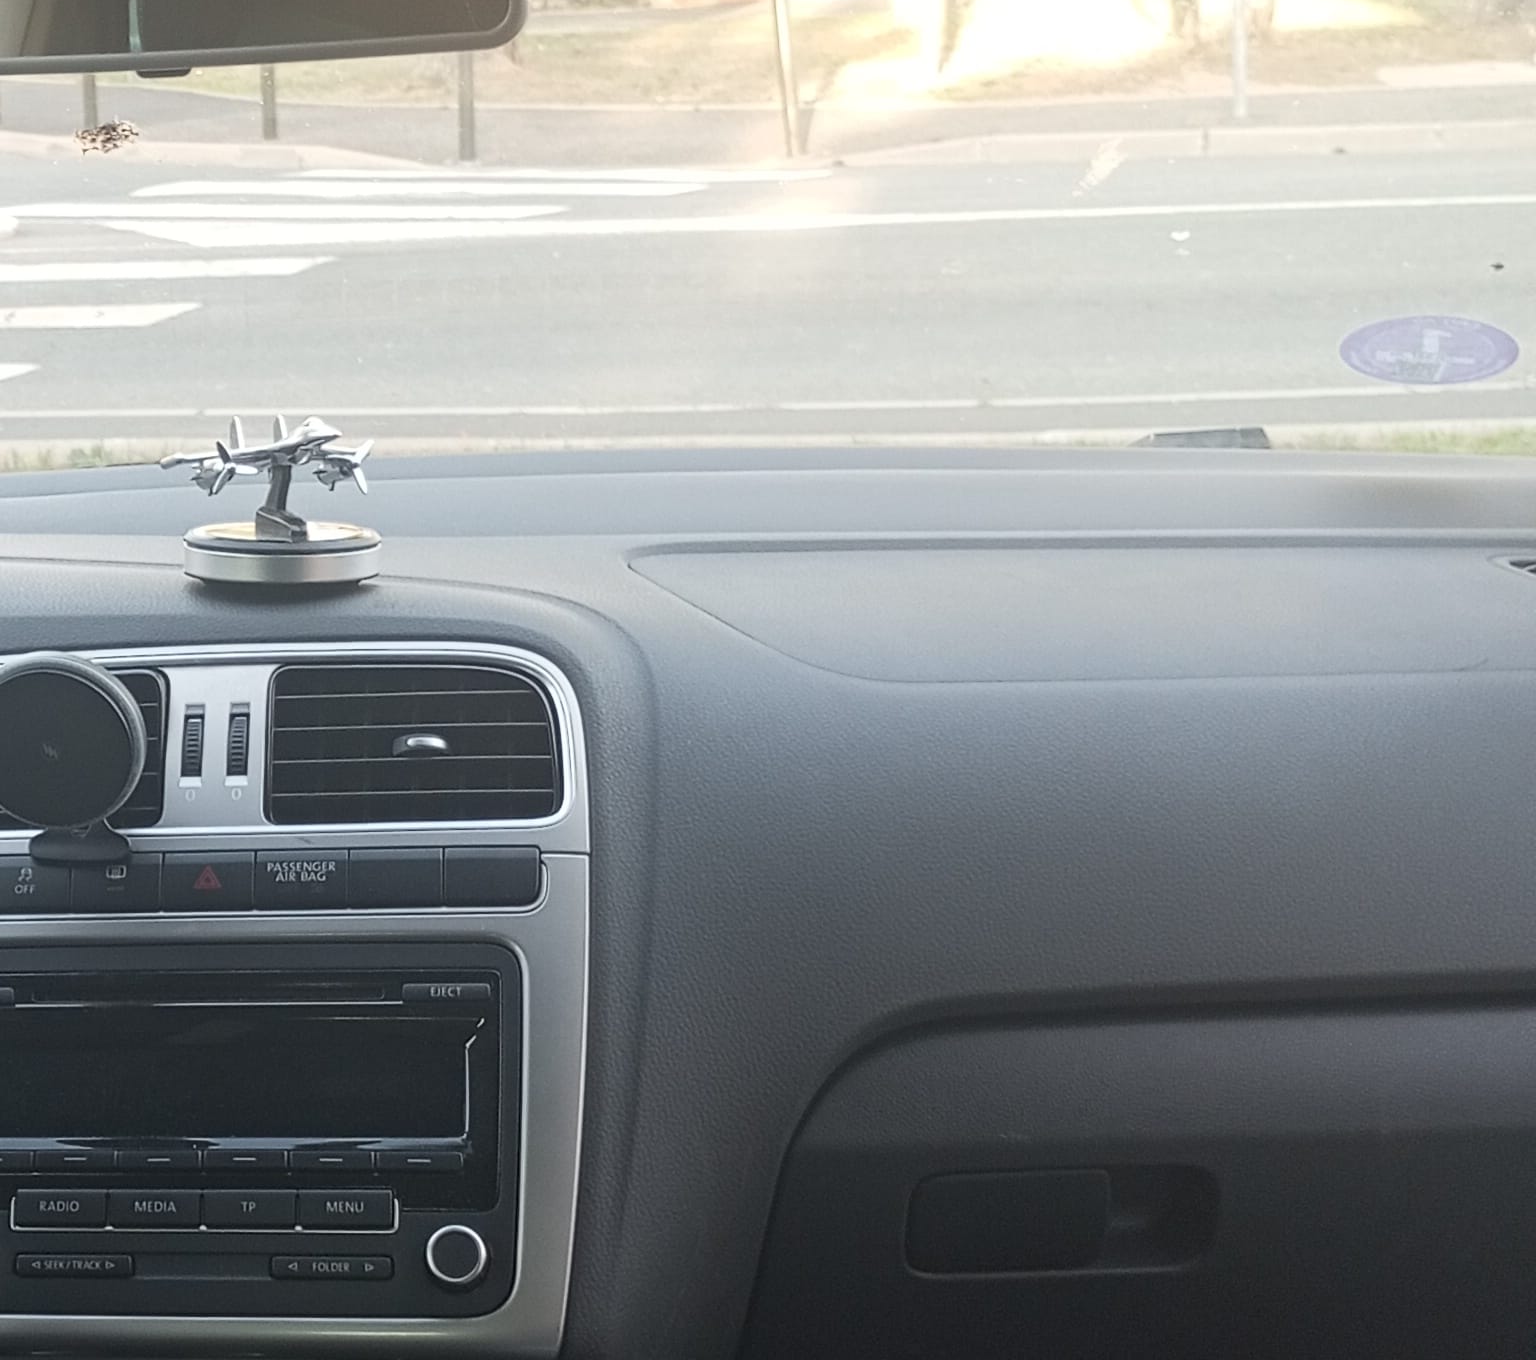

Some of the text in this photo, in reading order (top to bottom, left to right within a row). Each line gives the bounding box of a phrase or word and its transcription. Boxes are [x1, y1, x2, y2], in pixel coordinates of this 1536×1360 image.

[267, 861, 336, 872] PASSENGER
[275, 871, 326, 882] AIR BAG
[15, 884, 36, 894] OFF
[430, 986, 462, 997] EJECT
[39, 1200, 80, 1212] RADIO
[134, 1200, 177, 1213] MEDIA
[241, 1201, 256, 1212] TP
[326, 1201, 364, 1213] MENU
[312, 1262, 350, 1272] FOLDER
